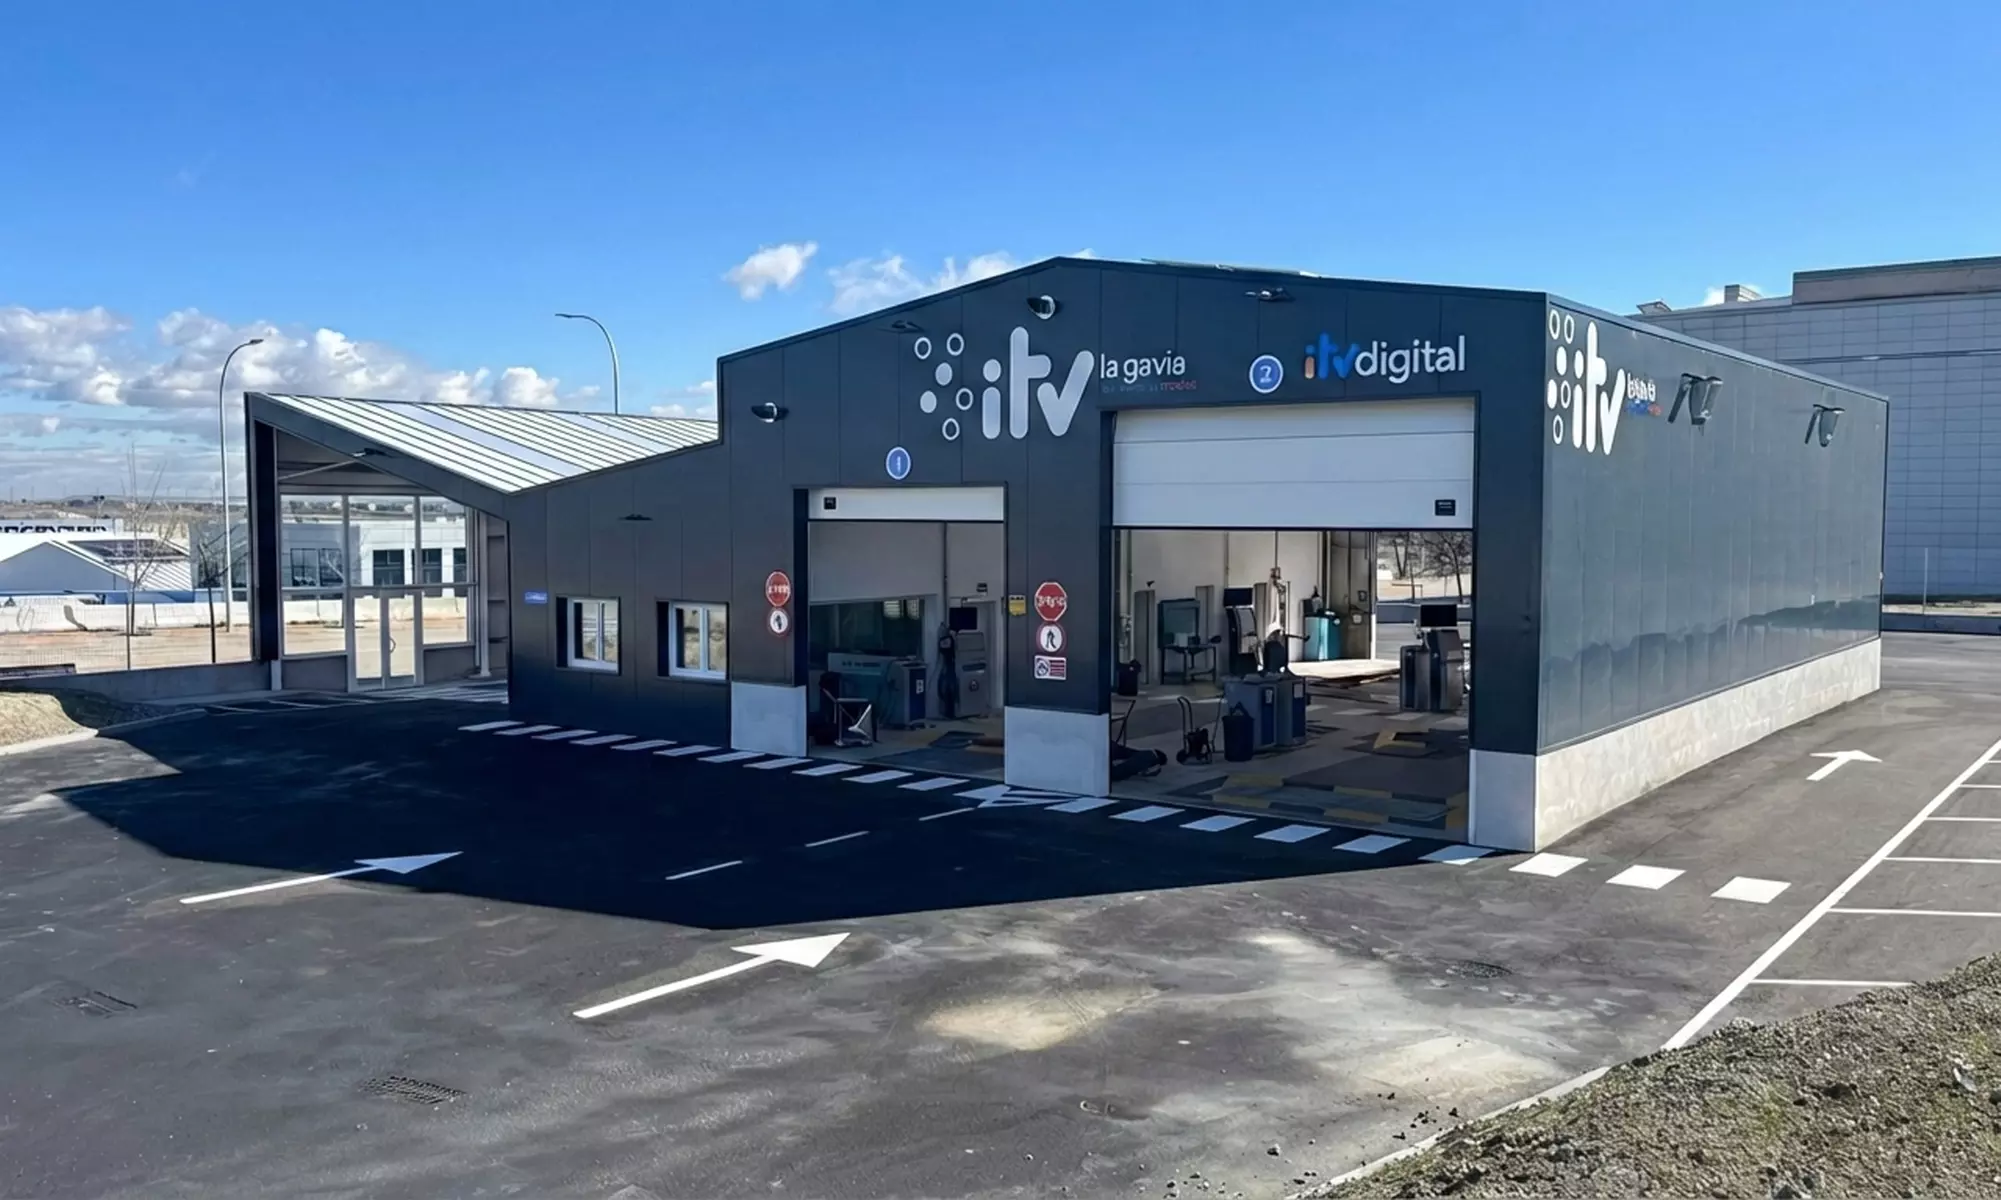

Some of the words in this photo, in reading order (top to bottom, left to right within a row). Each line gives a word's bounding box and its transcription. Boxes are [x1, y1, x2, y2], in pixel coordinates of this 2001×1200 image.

[982, 326, 1095, 440] itv
[1100, 353, 1119, 379] la
[1123, 349, 1186, 385] gavia
[1259, 364, 1272, 384] 2
[1572, 321, 1627, 456] itv
